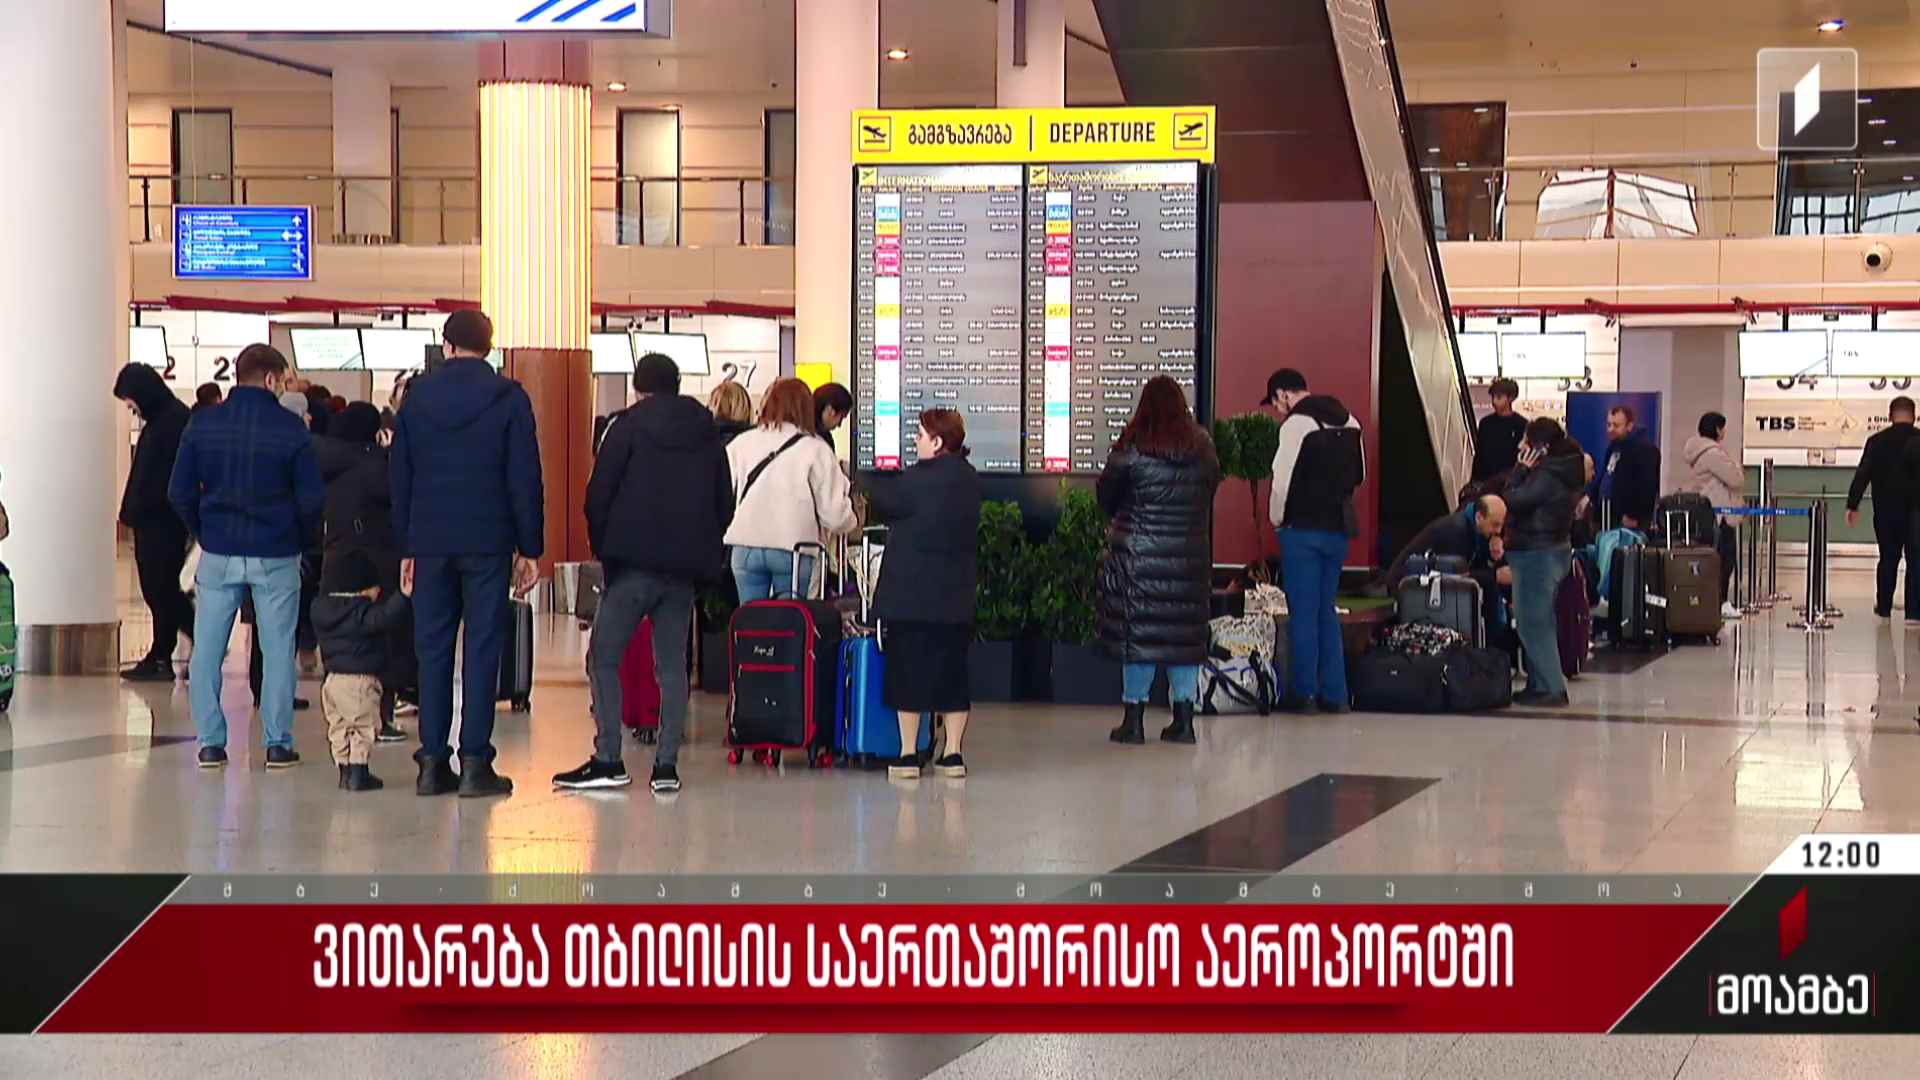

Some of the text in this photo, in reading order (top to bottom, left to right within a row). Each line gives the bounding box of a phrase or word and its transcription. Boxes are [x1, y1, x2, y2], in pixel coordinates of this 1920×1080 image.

[908, 123, 1012, 145] გამგზავრება
[1049, 121, 1156, 143] DEPARTURE
[721, 362, 757, 388] 27
[1756, 416, 1796, 431] TBS
